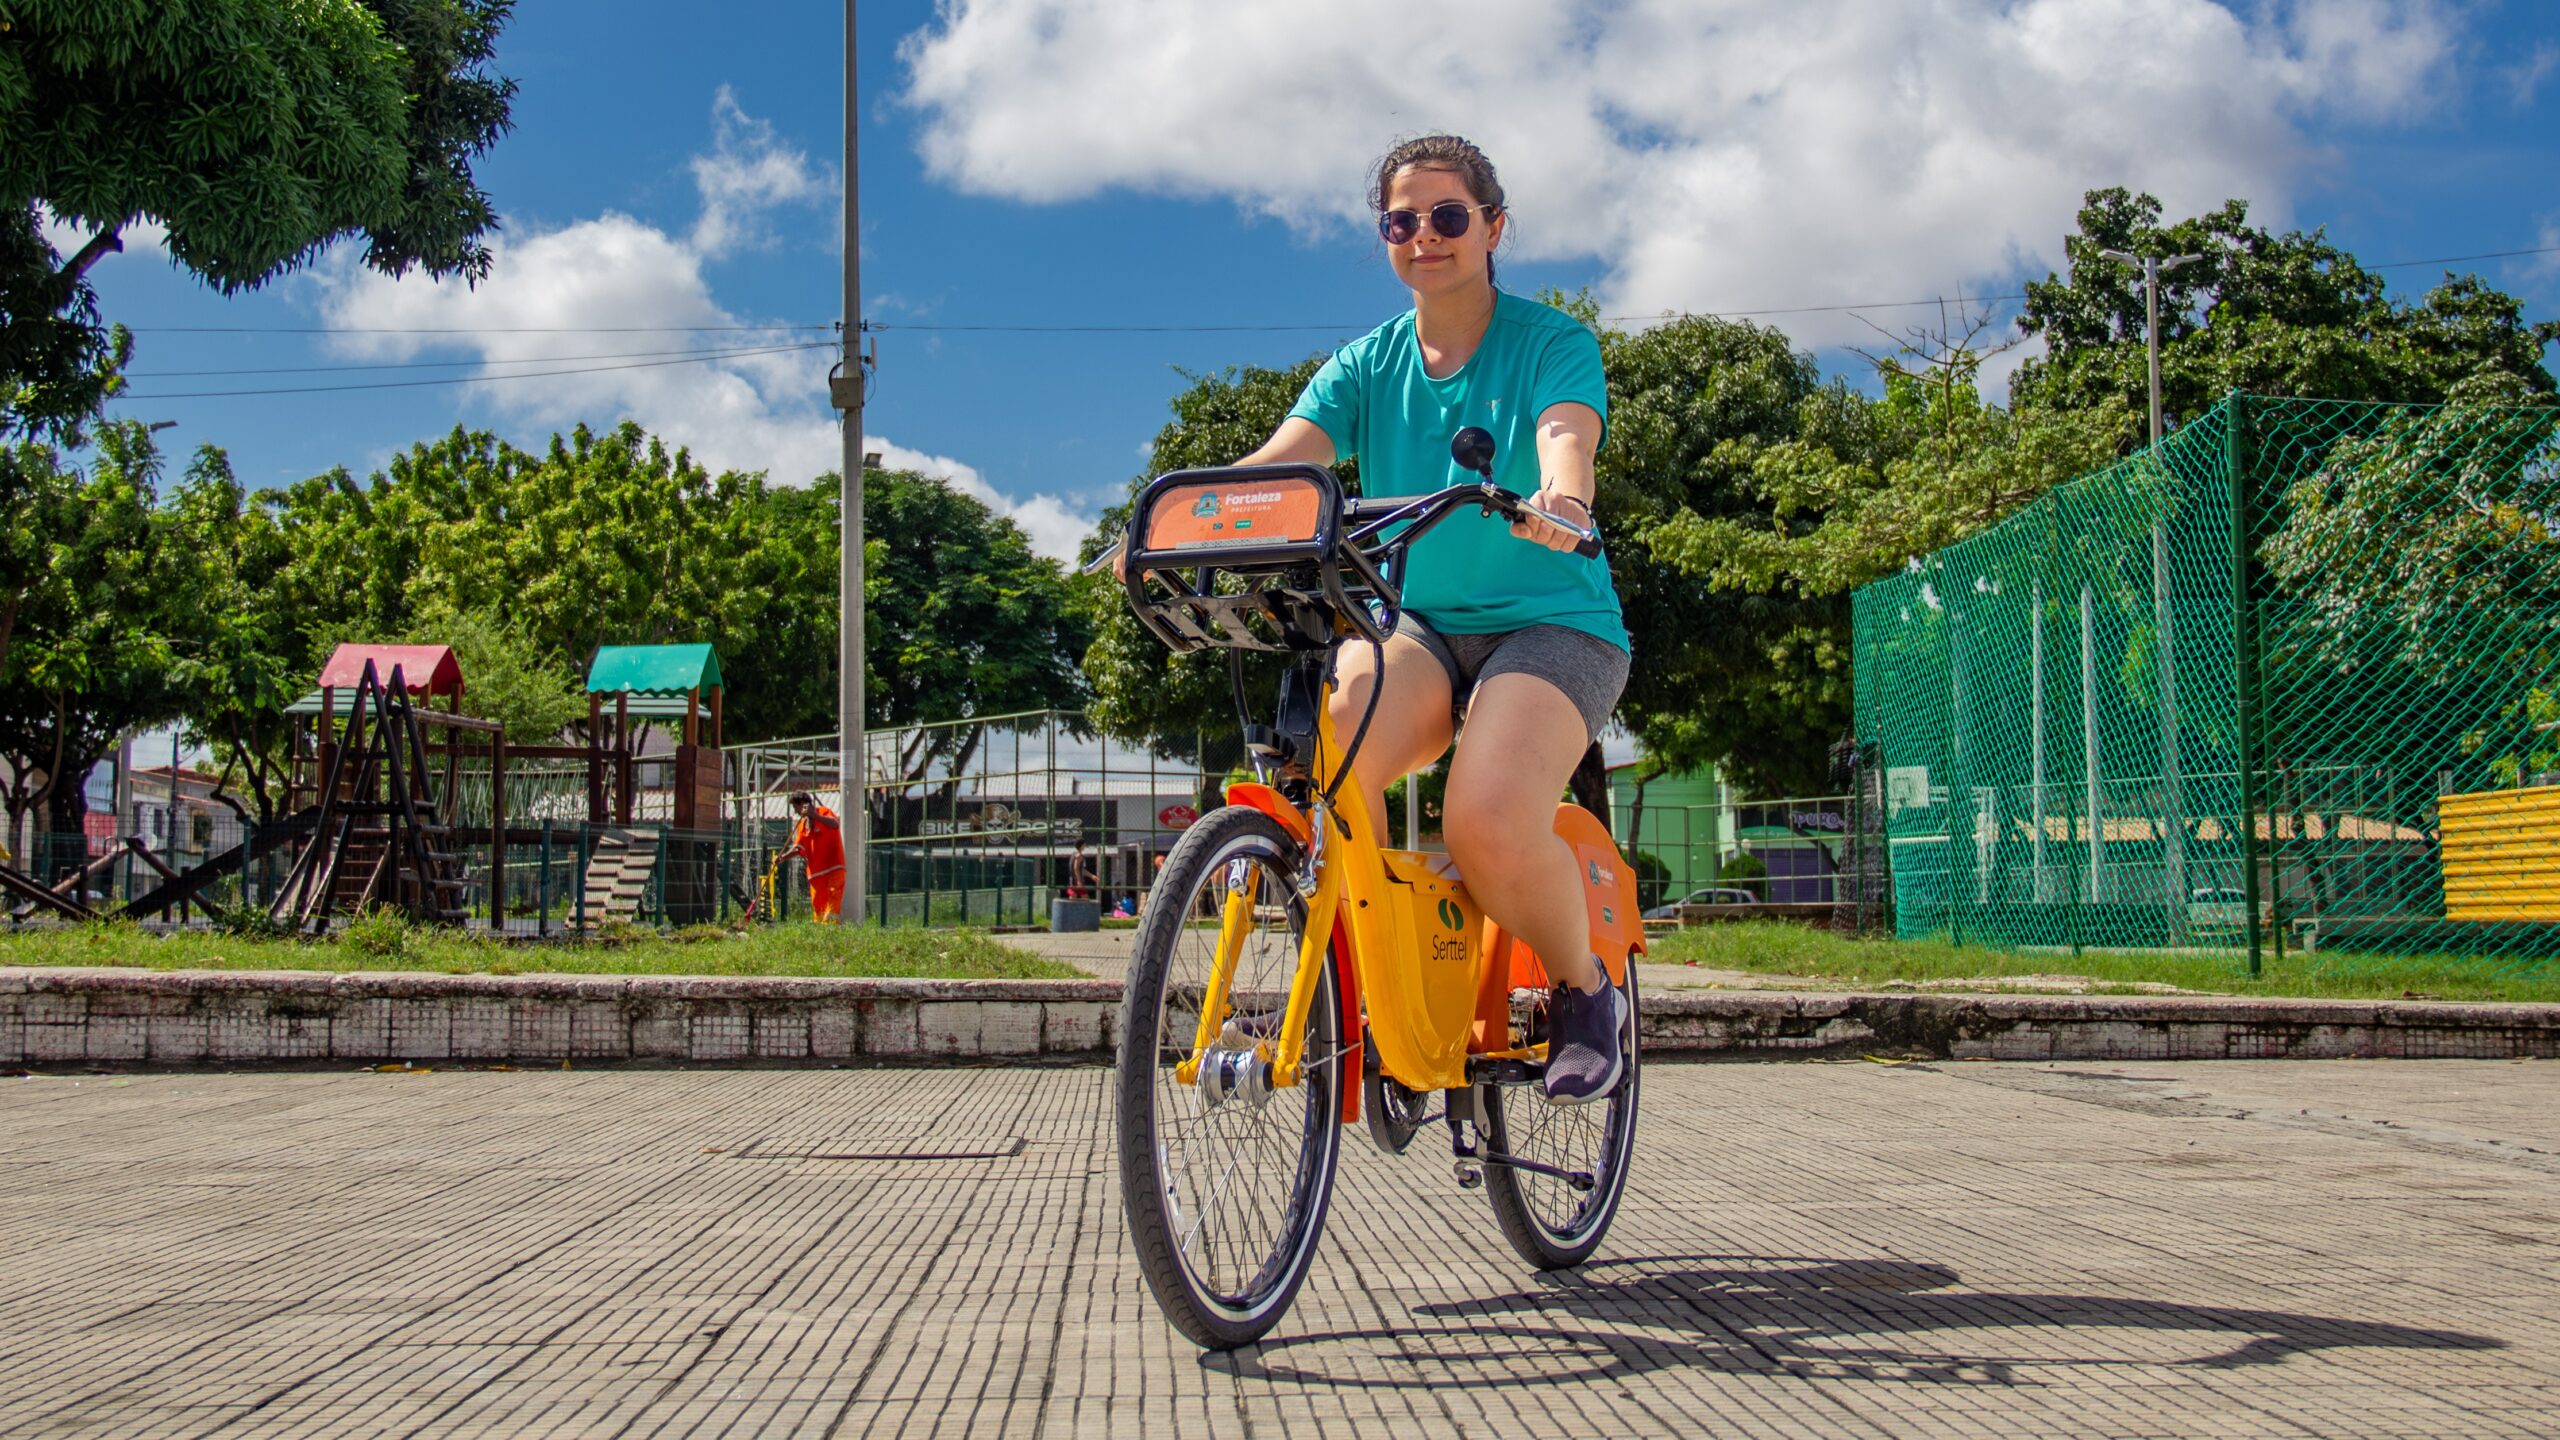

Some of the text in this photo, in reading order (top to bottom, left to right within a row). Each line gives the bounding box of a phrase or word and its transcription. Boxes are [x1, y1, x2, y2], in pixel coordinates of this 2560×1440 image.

[1225, 492, 1281, 505] Fortaleza
[920, 821, 972, 836] BIKE
[1432, 934, 1467, 961] Serttel
